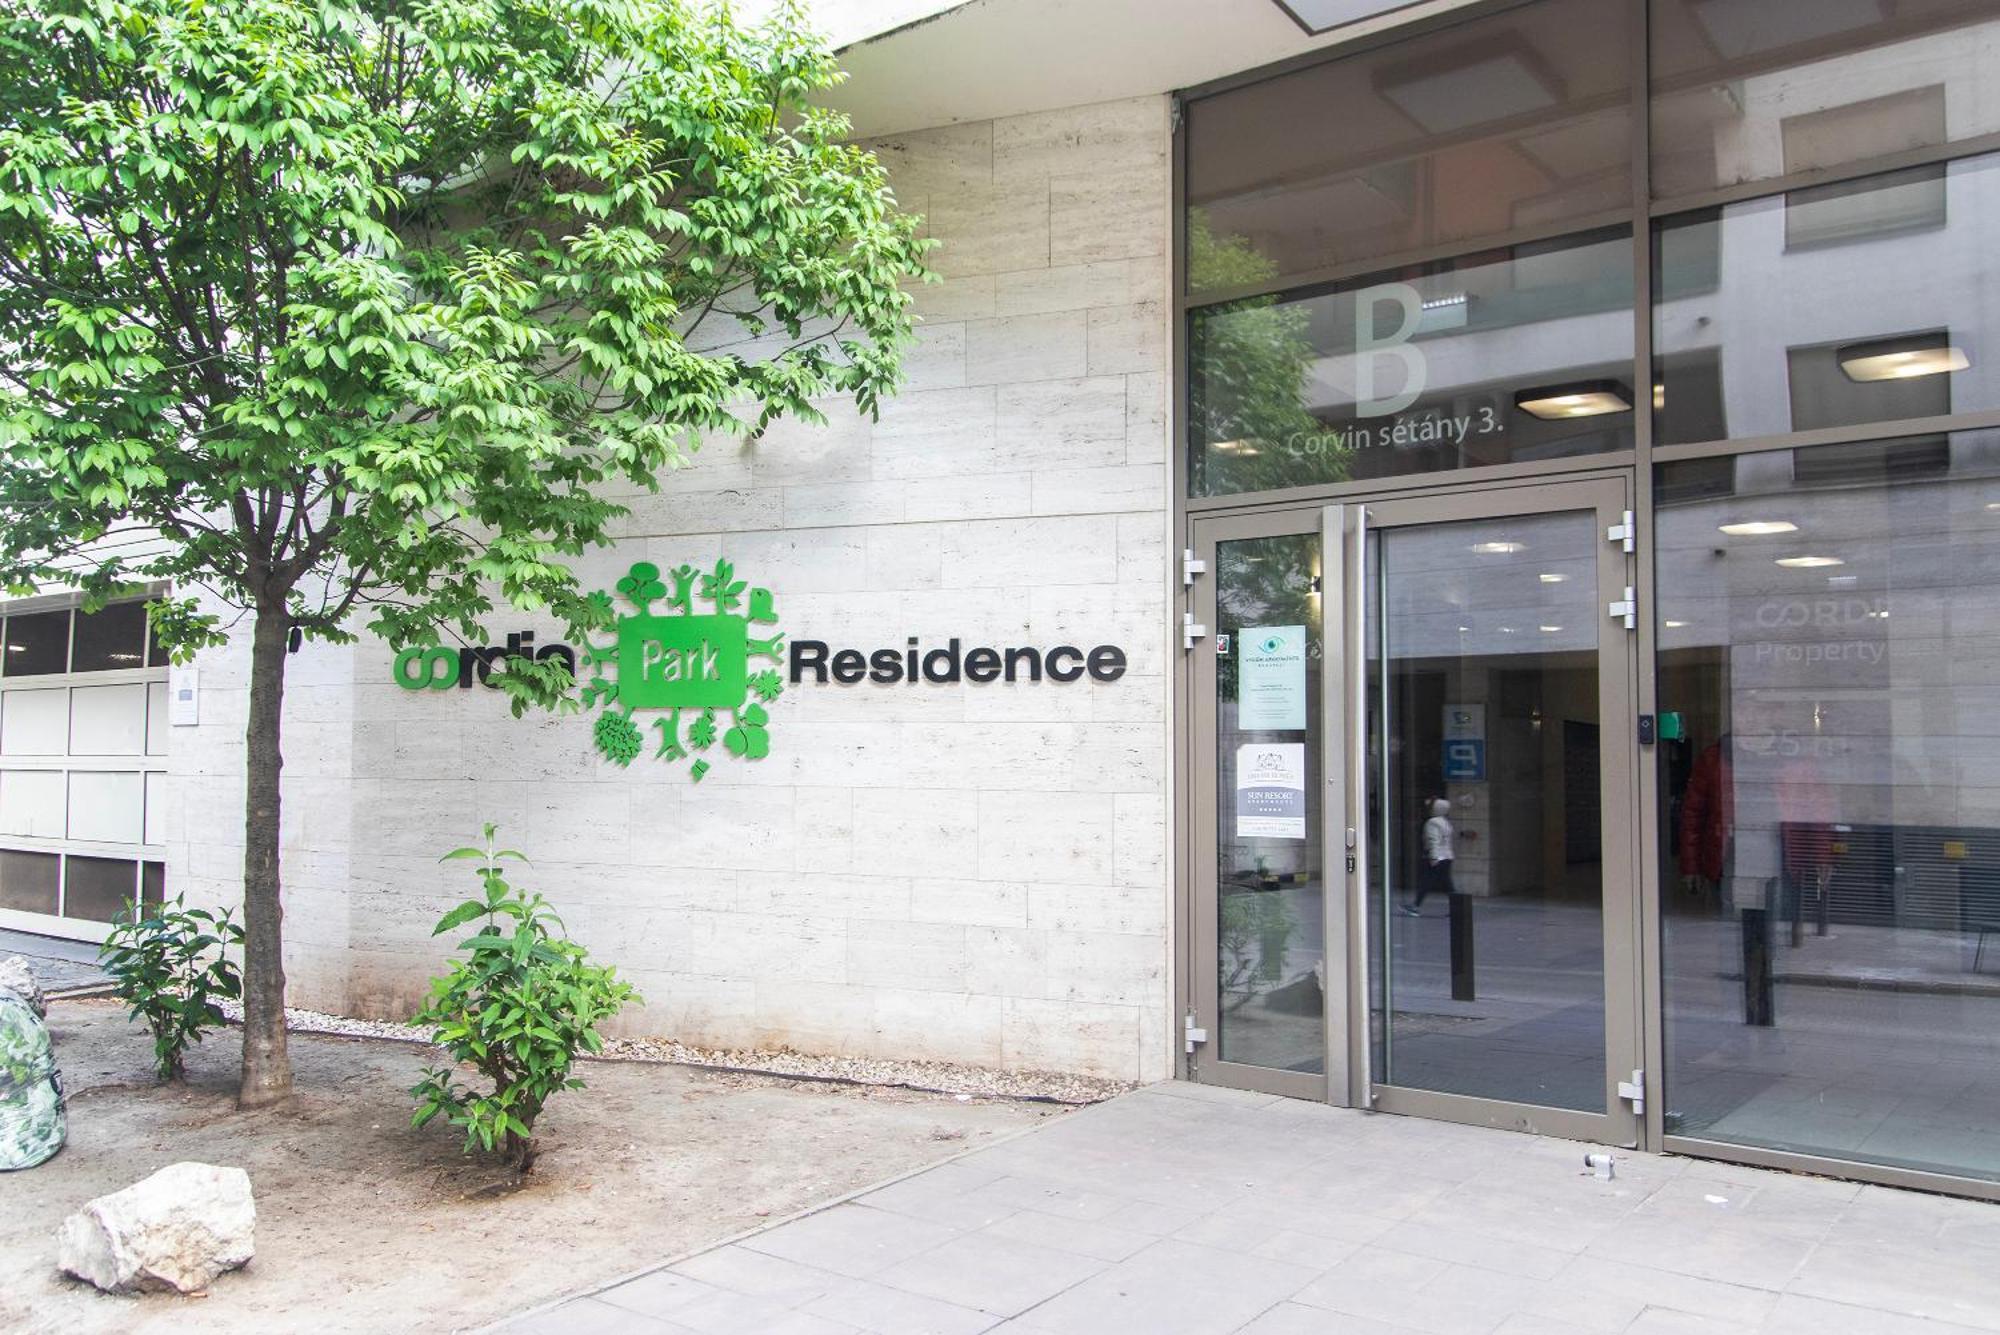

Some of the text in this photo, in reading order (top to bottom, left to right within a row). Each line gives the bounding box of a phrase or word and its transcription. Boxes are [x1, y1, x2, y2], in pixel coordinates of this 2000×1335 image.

[1355, 283, 1427, 418] B
[1288, 407, 1504, 456] Corvin sétány 3.
[642, 638, 720, 682] Park
[789, 637, 1127, 684] Residence
[1755, 639, 1886, 666] Property
